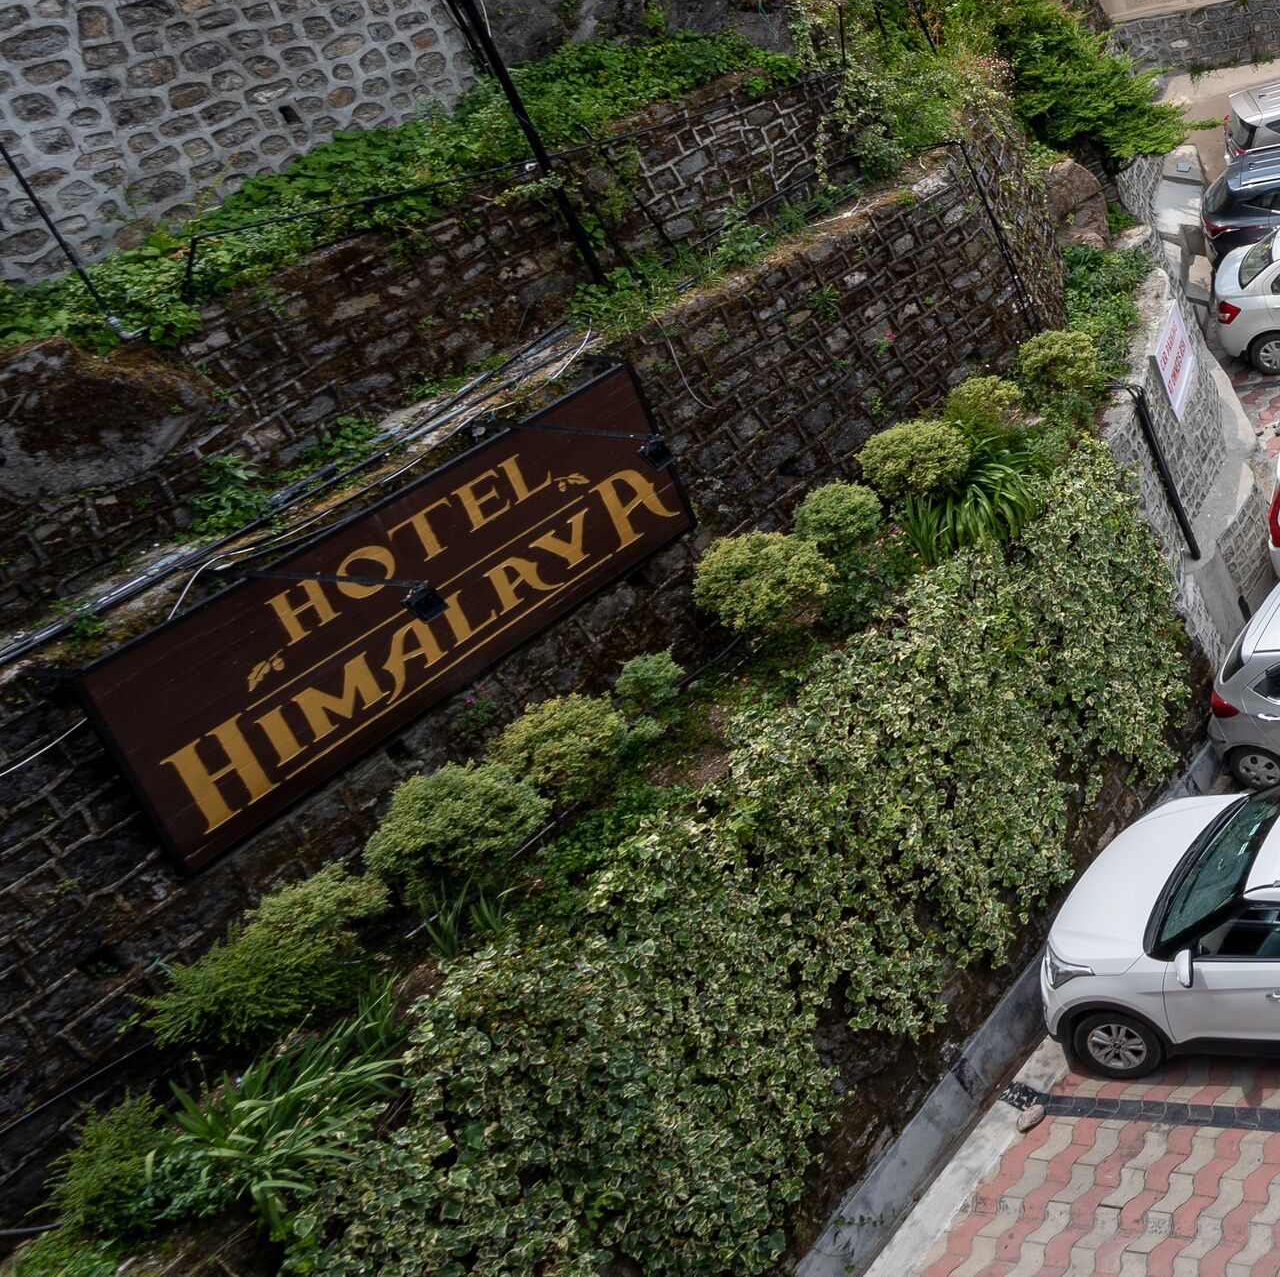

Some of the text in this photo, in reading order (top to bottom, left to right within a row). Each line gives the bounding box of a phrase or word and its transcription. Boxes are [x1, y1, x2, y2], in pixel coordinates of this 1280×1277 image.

[1165, 320, 1177, 356] PARKING
[266, 453, 554, 645] HOTEL
[160, 469, 680, 835] HIMALAYA
